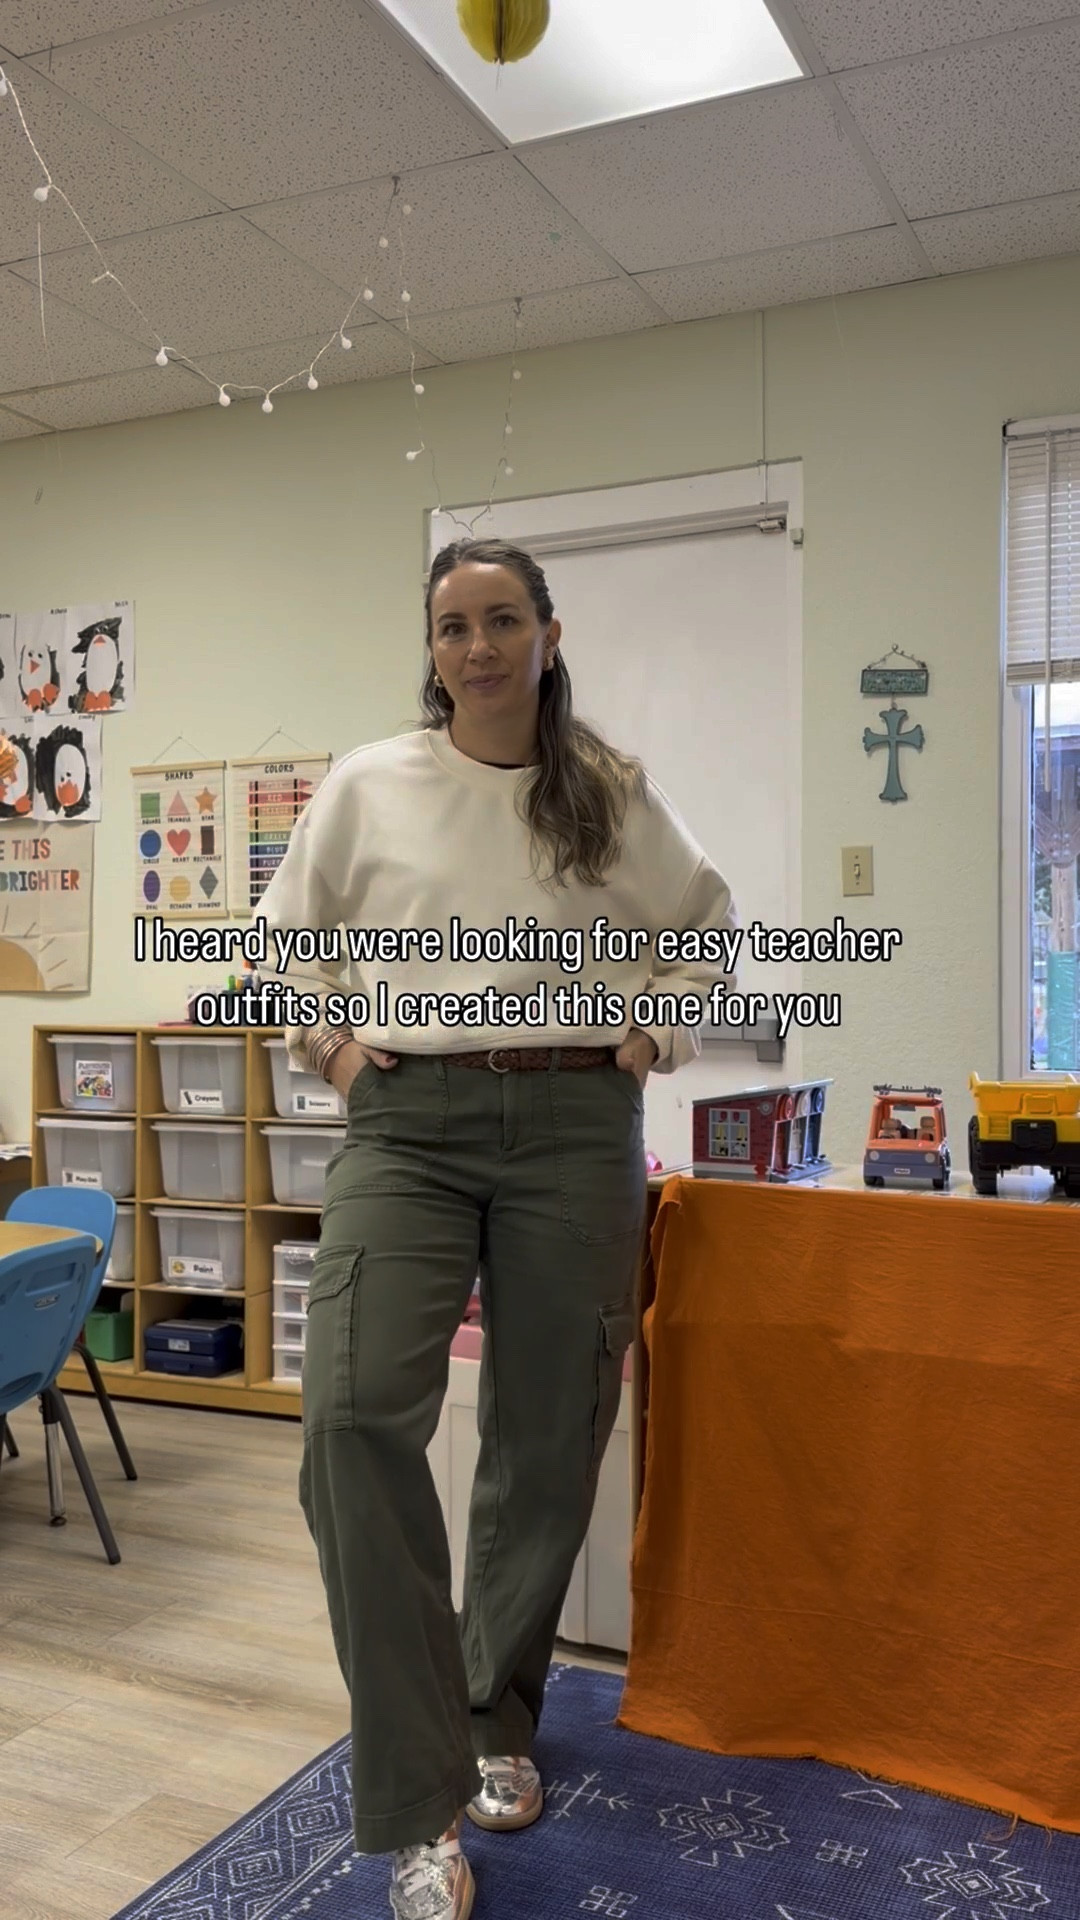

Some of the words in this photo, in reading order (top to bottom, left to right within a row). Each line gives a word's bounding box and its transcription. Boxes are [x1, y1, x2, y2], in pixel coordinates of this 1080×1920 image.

[165, 771, 194, 781] SHAPES
[264, 764, 294, 774] COLORS
[12, 838, 51, 860] THIS
[0, 869, 80, 892] BRIGHTER
